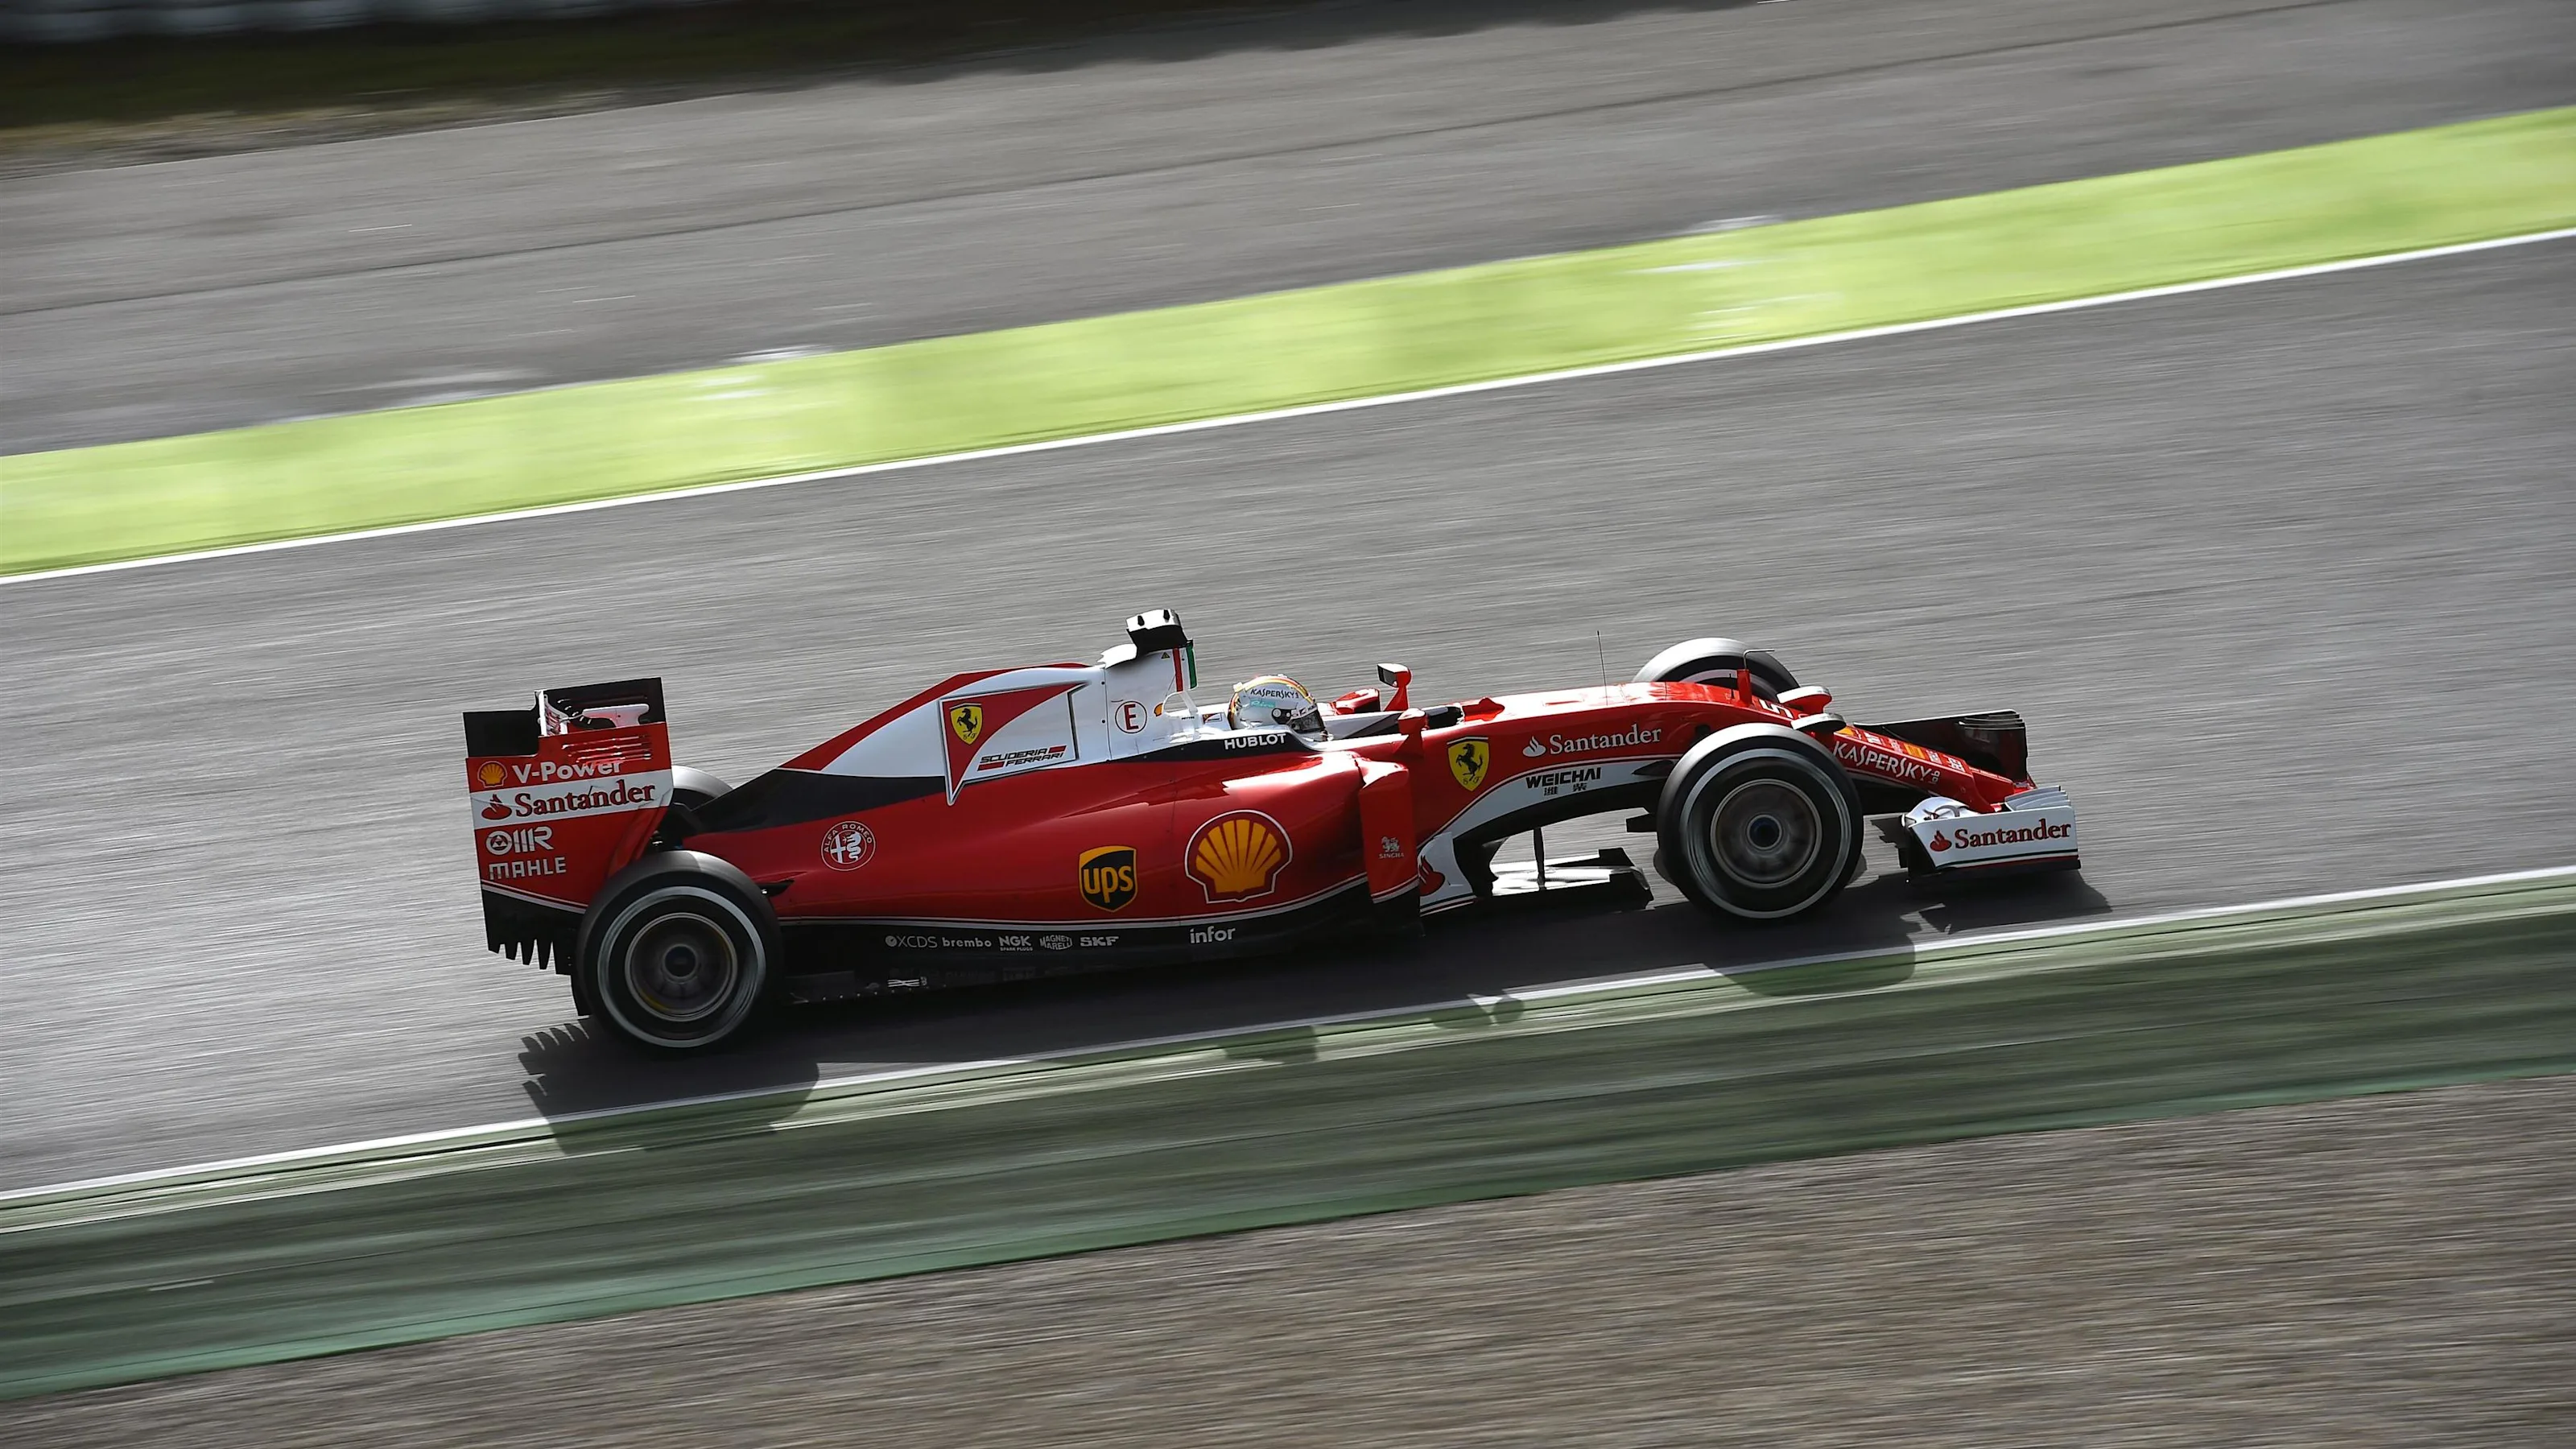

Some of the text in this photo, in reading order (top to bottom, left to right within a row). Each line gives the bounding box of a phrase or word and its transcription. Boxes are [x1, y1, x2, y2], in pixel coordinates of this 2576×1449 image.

[1250, 688, 1295, 699] KASPERSKY
[1124, 704, 1139, 730] E
[1224, 733, 1286, 749] HUBLOT
[1550, 724, 1662, 754] Santander
[980, 748, 1048, 764] SCUDERIA
[1005, 752, 1064, 767] FERRARI
[1833, 741, 1932, 781] KASPERSKY
[512, 760, 624, 784] V-Power
[1525, 767, 1601, 789] WEICHAI
[514, 779, 656, 817] Santander
[824, 824, 873, 853] ALFA ROMEO
[1954, 818, 2071, 849] Santander
[489, 857, 567, 880] MAHLE
[1084, 865, 1133, 903] ups
[942, 937, 992, 947] brembo
[998, 935, 1031, 947] NGK
[1080, 936, 1119, 947] SKF
[1190, 926, 1236, 943] infor
